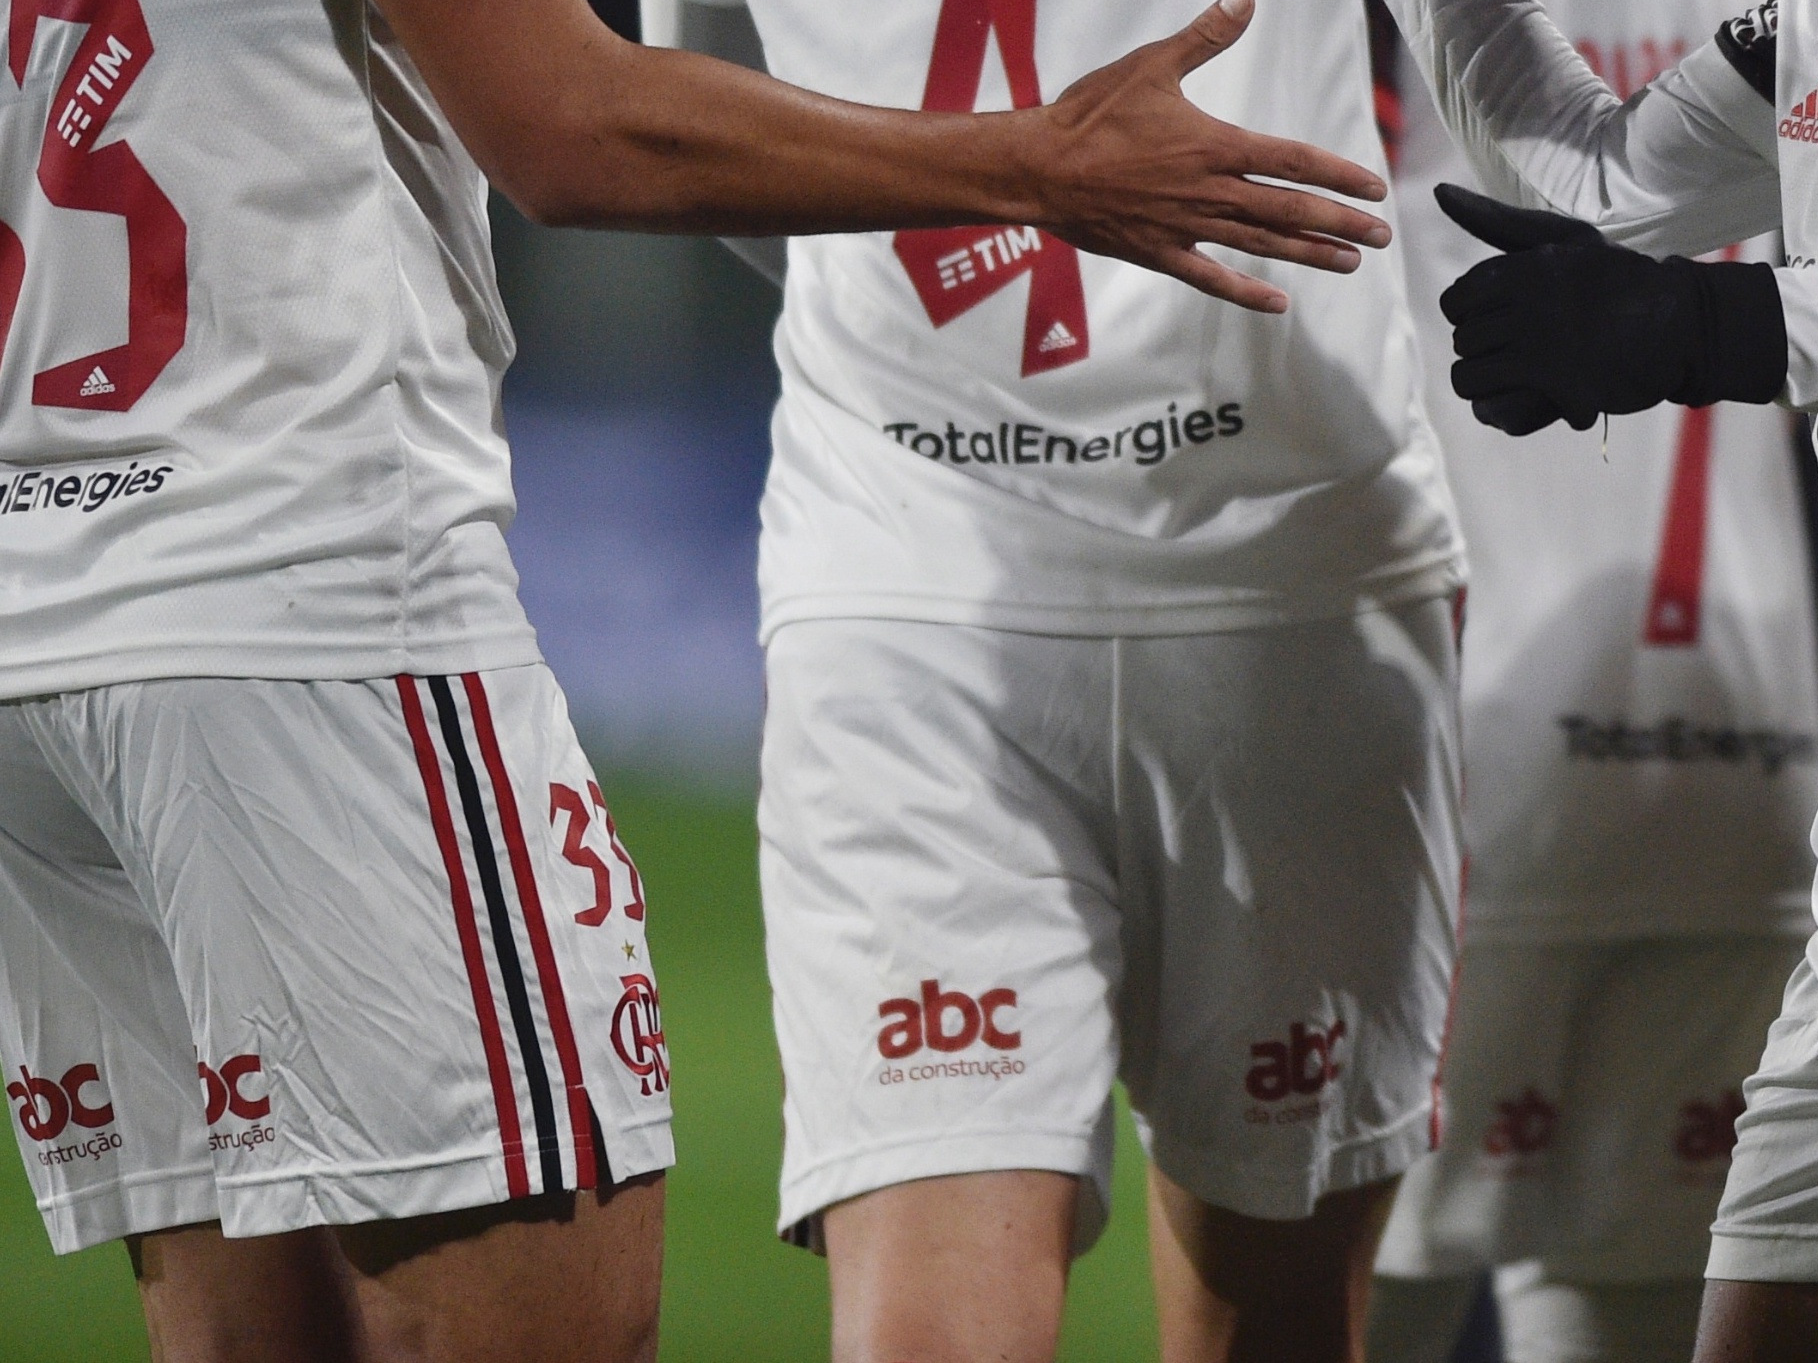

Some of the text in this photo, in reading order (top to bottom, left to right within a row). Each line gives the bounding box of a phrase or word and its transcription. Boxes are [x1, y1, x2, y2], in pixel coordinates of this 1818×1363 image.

[76, 34, 133, 106] TIM
[974, 226, 1043, 274] TIM
[80, 384, 116, 397] adidas
[883, 401, 1245, 466] TotalEnergies
[877, 978, 1022, 1061] abc
[7, 1064, 115, 1142] abc
[879, 1056, 1026, 1086] da construção
